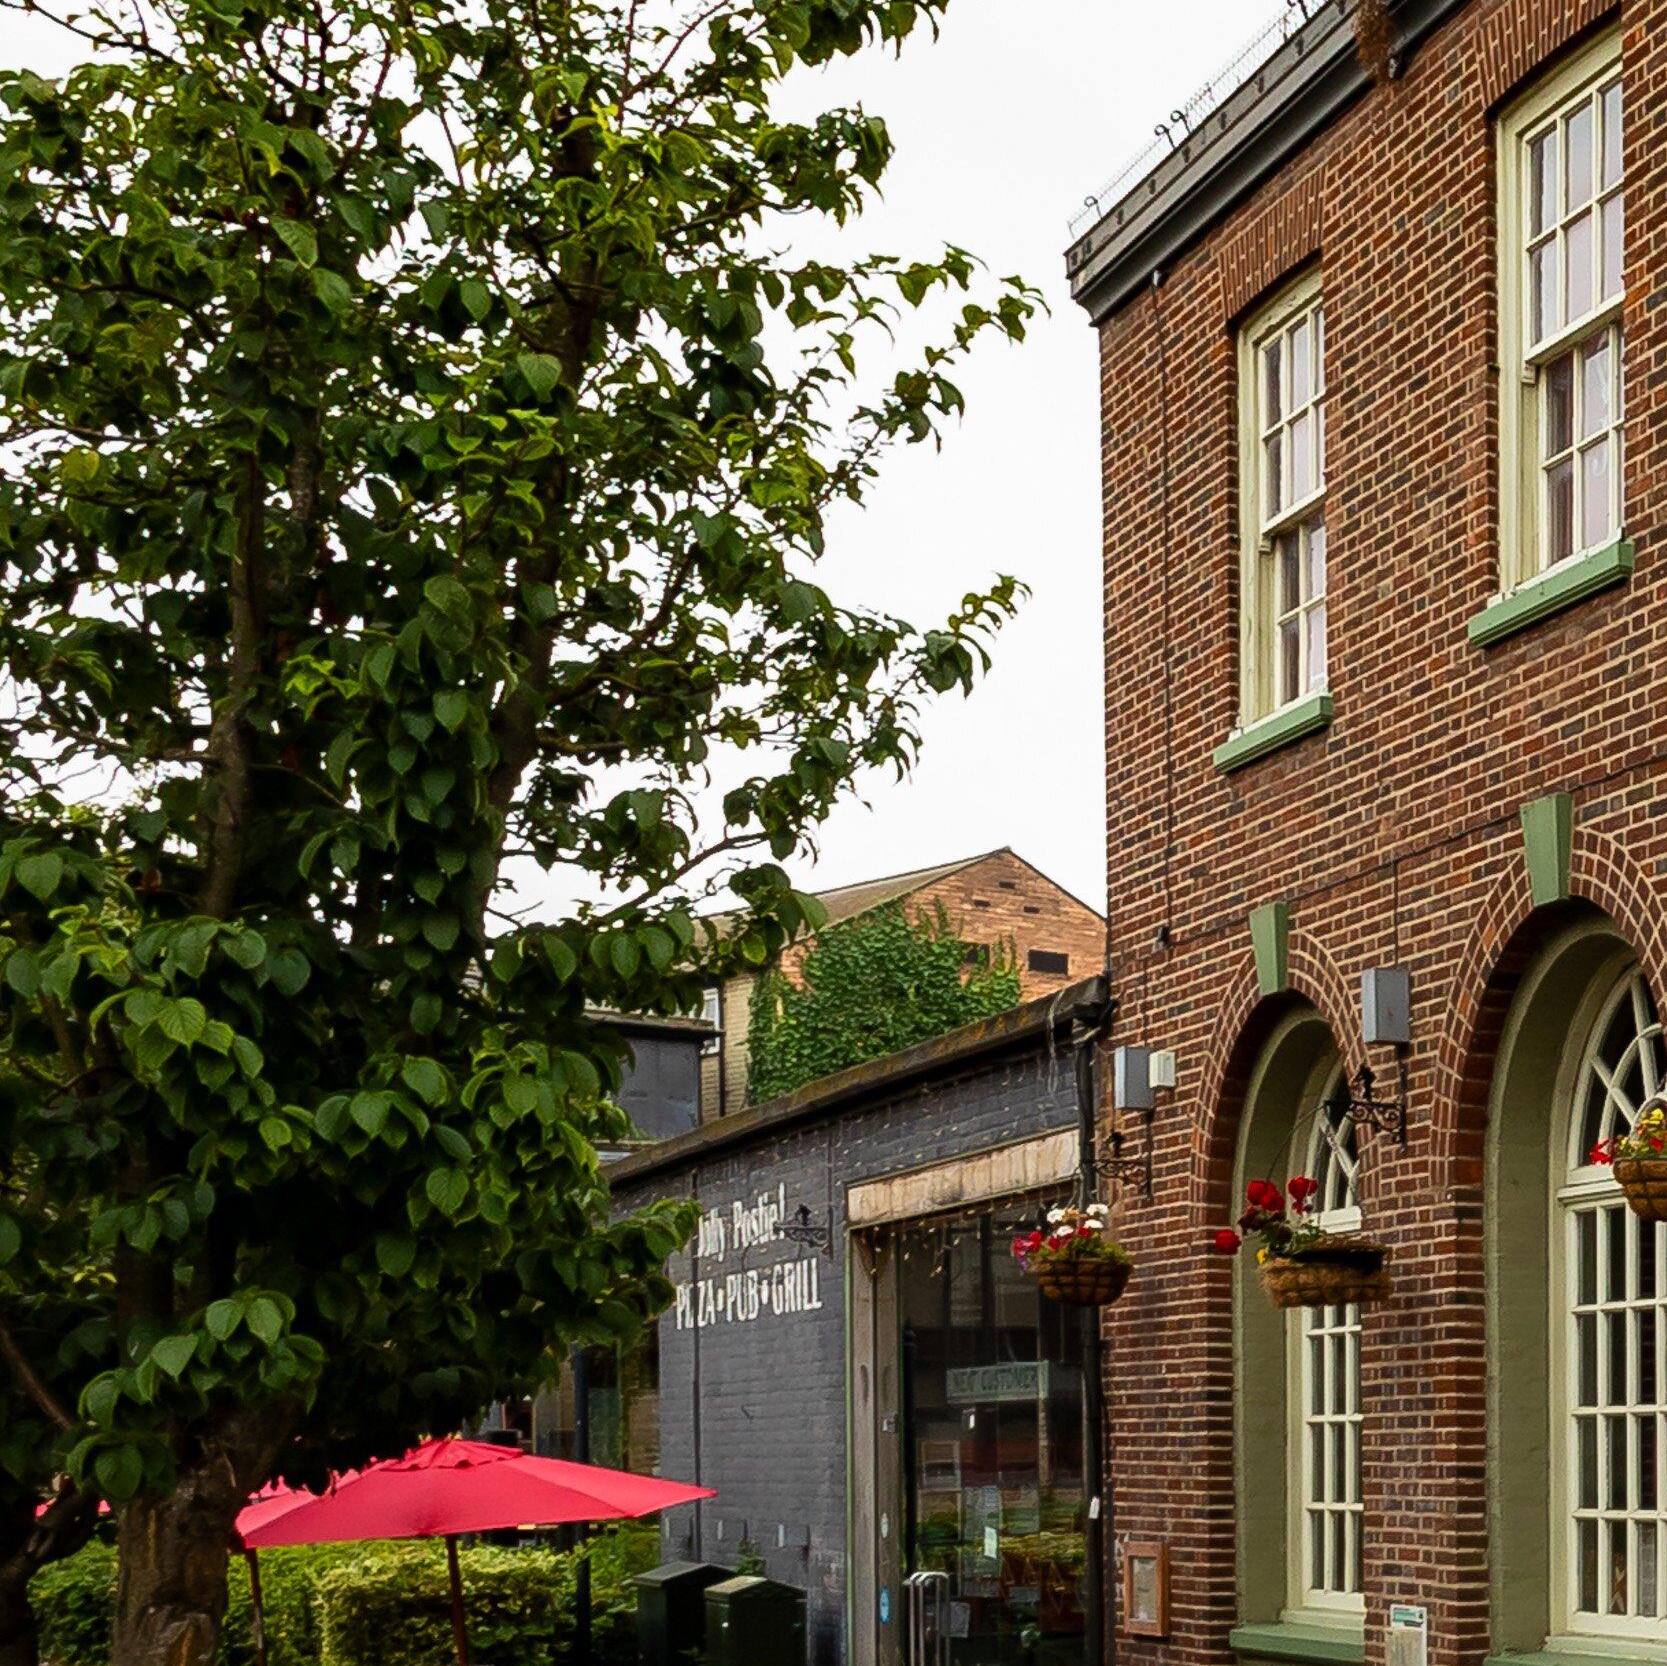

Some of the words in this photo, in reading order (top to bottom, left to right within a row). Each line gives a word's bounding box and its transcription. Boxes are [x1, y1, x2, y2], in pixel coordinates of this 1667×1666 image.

[676, 1279, 716, 1331] PIZA
[726, 1269, 760, 1323] PUB
[772, 1257, 822, 1316] GRILL
